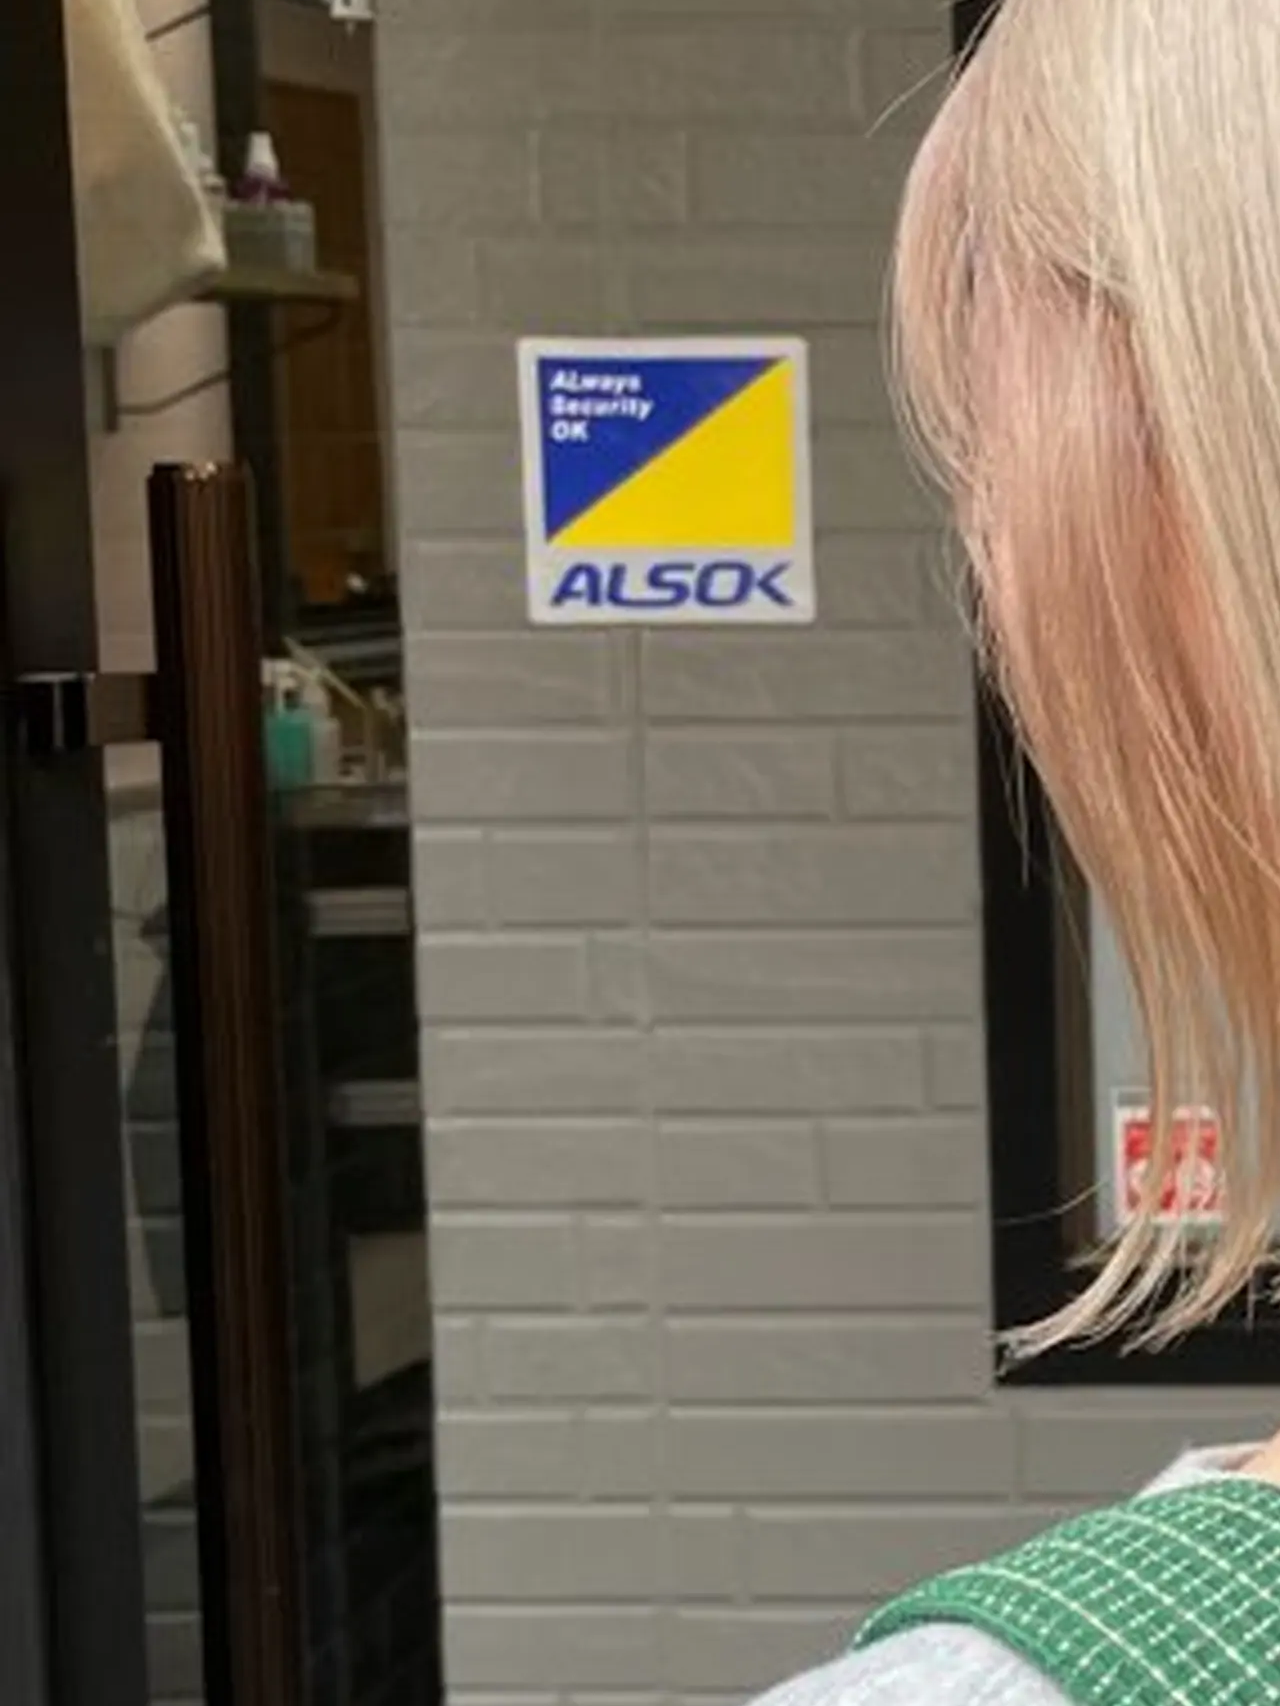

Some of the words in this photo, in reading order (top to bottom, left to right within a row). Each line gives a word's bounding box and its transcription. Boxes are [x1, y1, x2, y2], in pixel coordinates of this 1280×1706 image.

[550, 394, 654, 421] Security
[550, 420, 590, 442] OK
[550, 559, 795, 608] ALSOK
